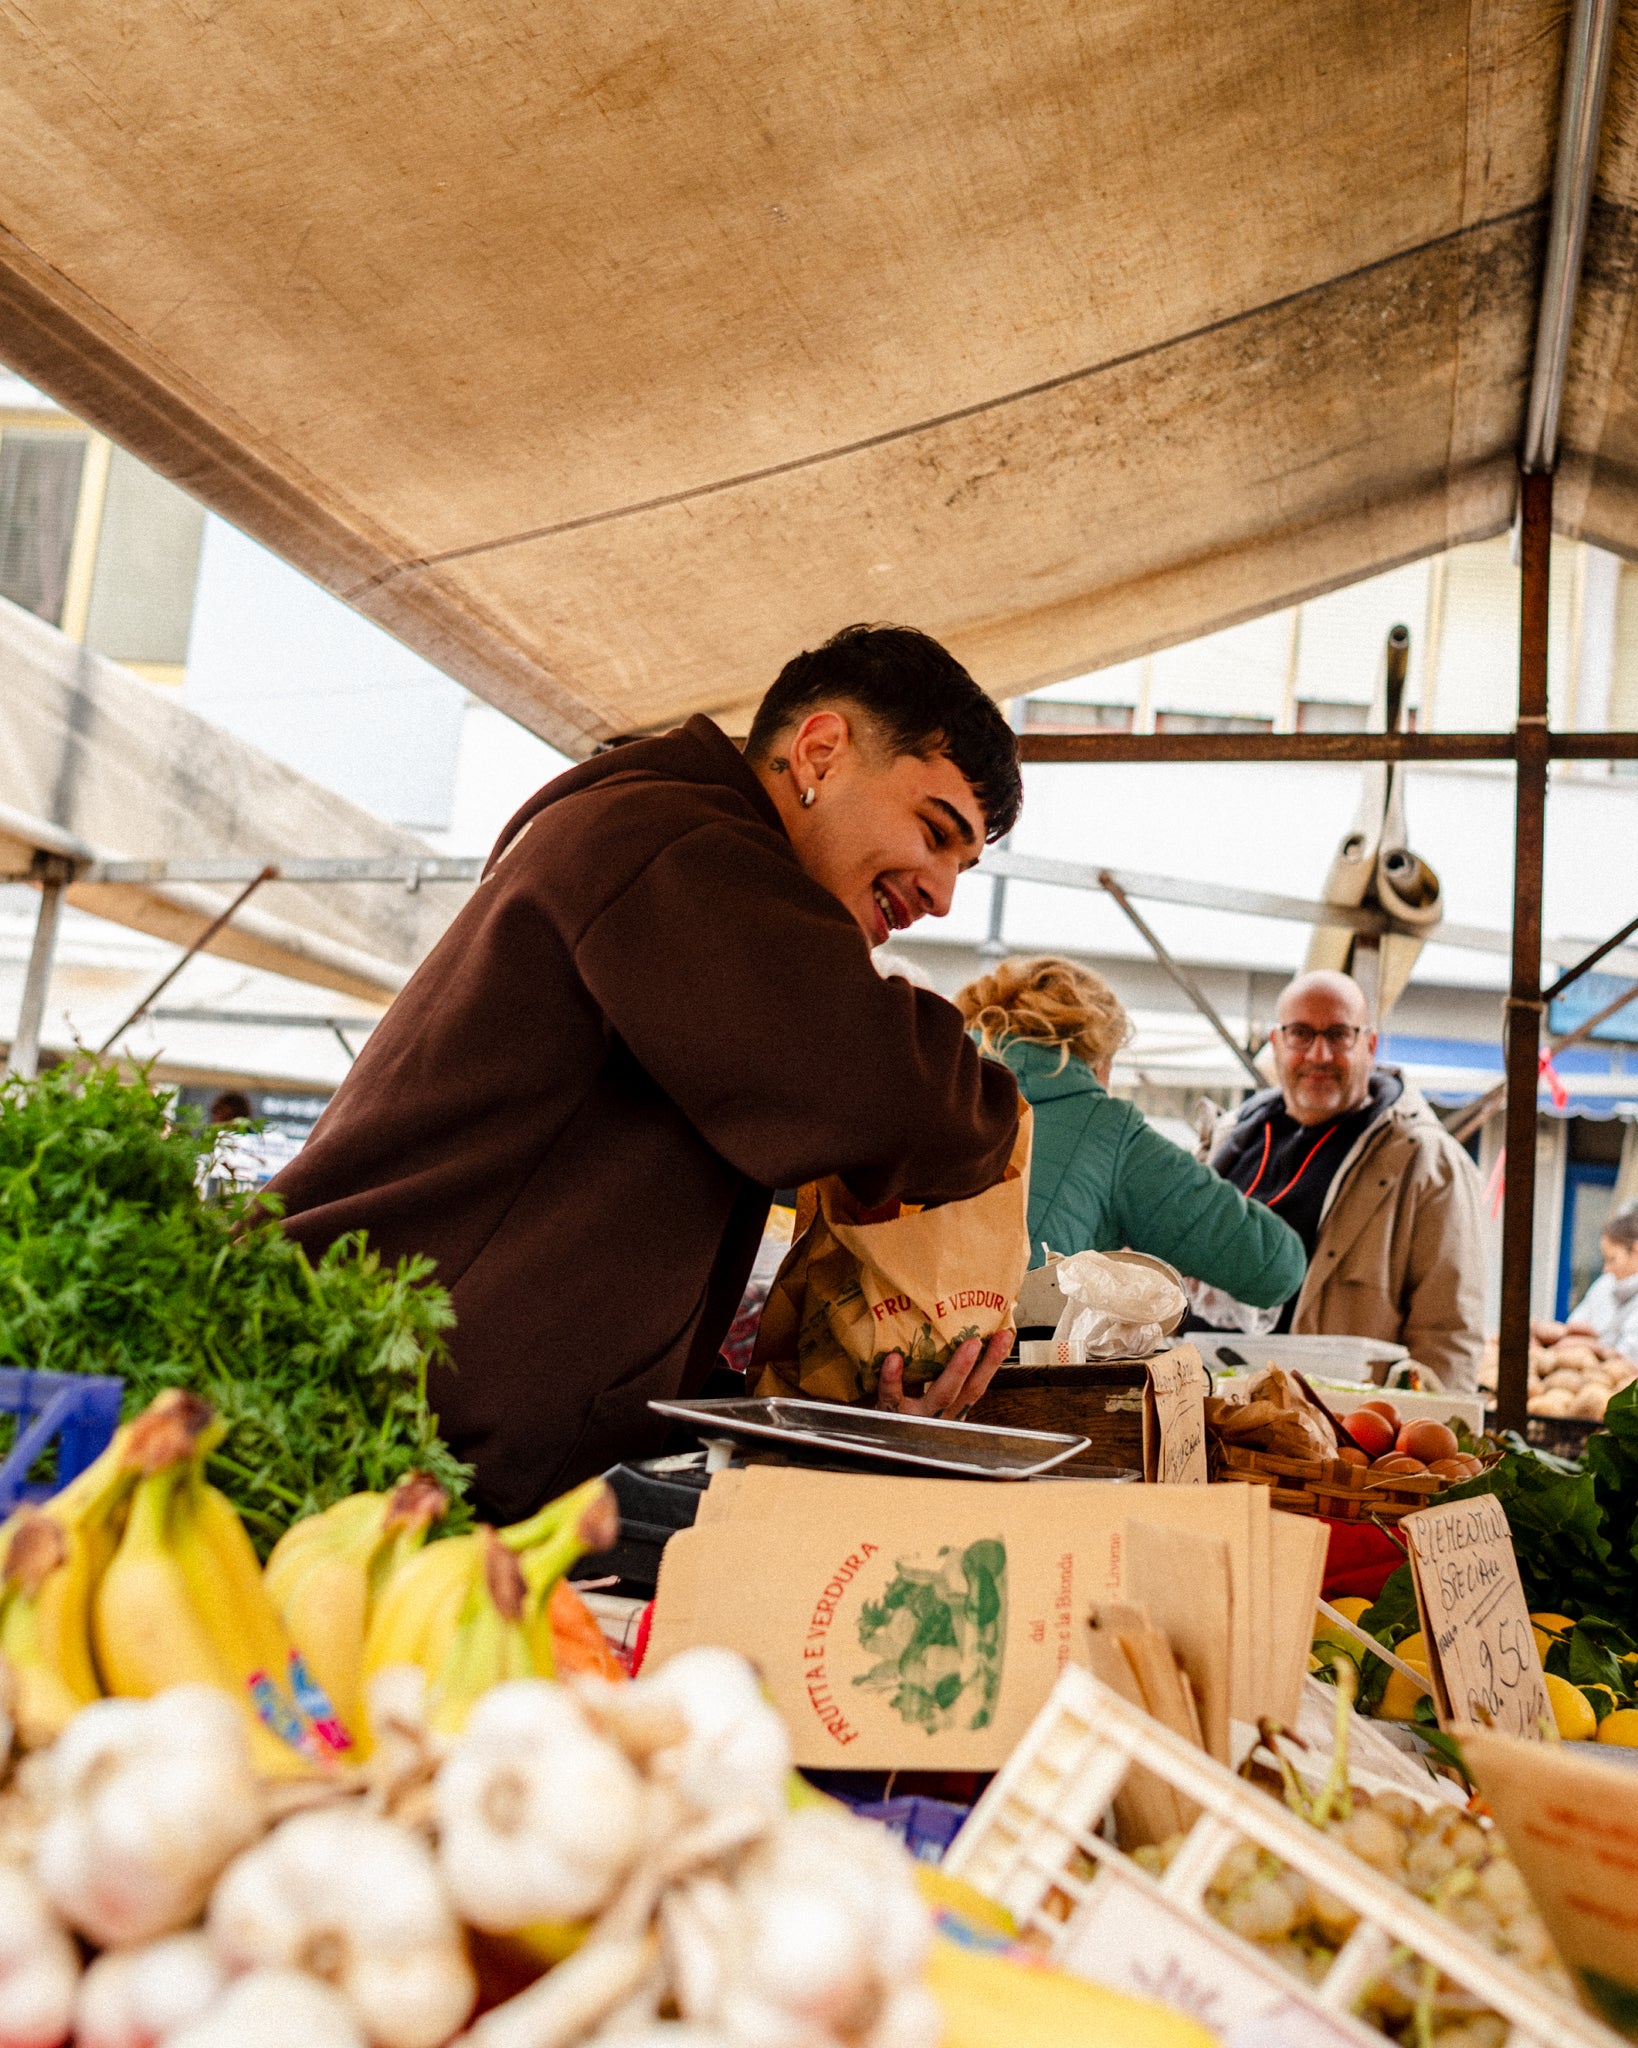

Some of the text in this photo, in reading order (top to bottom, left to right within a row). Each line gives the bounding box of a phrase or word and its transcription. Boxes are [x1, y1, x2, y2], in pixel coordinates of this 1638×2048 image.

[872, 1294, 932, 1322] FRU
[935, 1301, 947, 1319] E
[803, 1541, 880, 1746] FRUTTA E VERDURA
